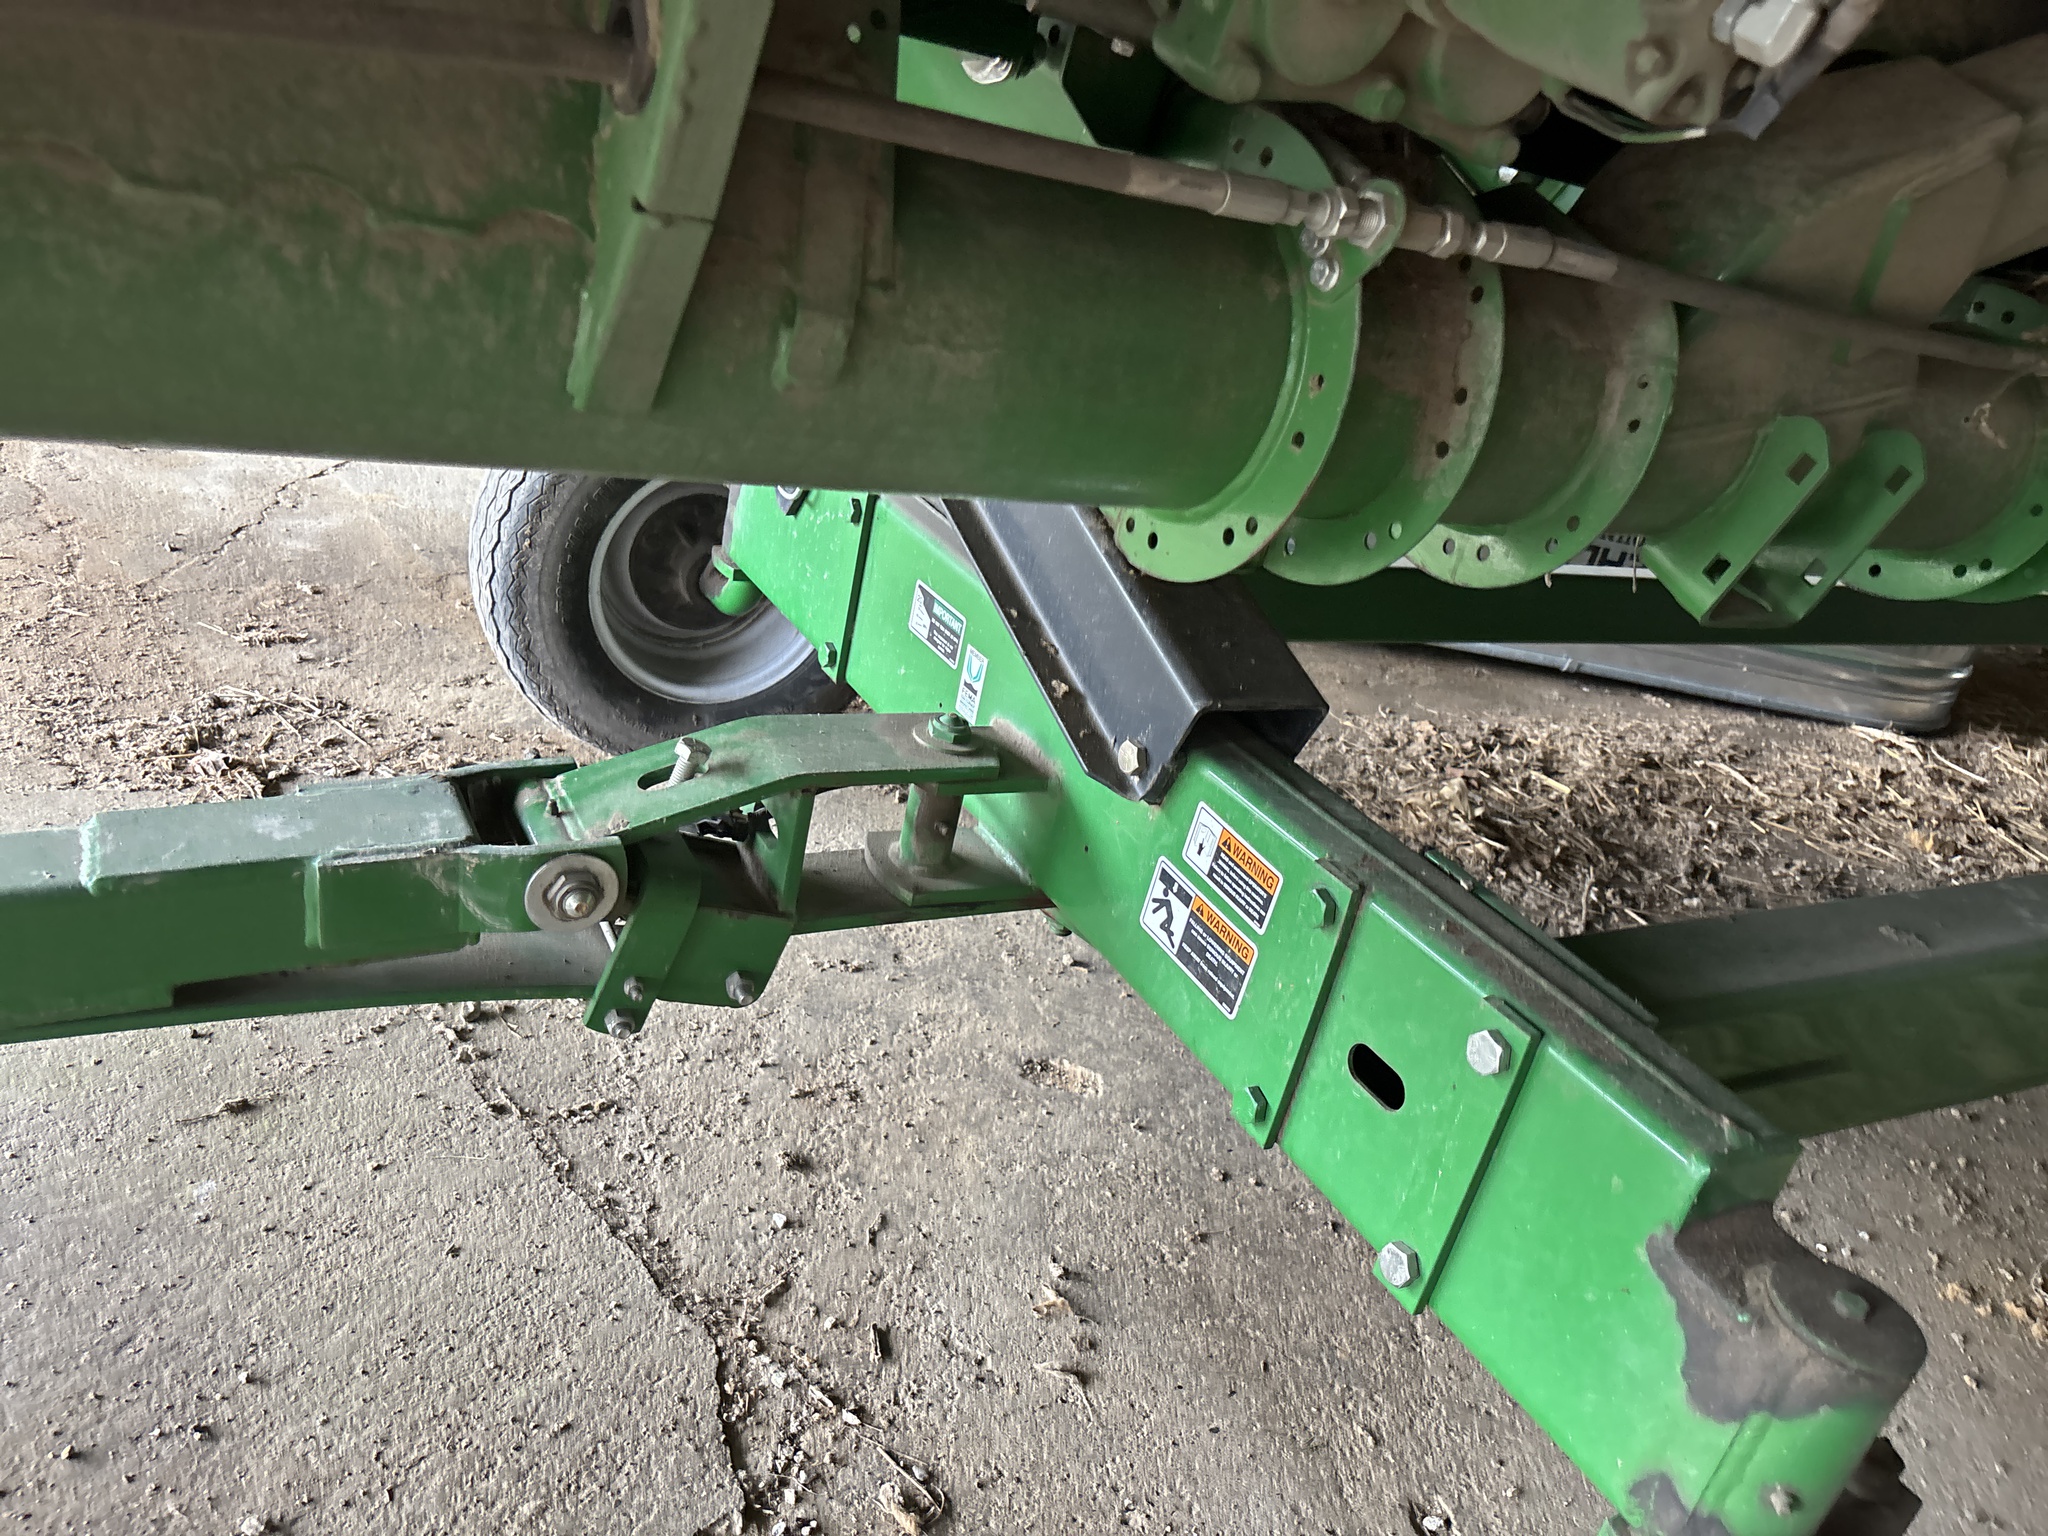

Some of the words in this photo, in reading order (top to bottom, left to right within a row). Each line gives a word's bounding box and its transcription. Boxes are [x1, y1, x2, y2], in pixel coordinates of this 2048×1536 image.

[932, 601, 962, 635] IMPORTANT
[961, 686, 976, 703] FEMA
[1232, 842, 1275, 890] WARNING
[1206, 910, 1250, 960] WARNING
